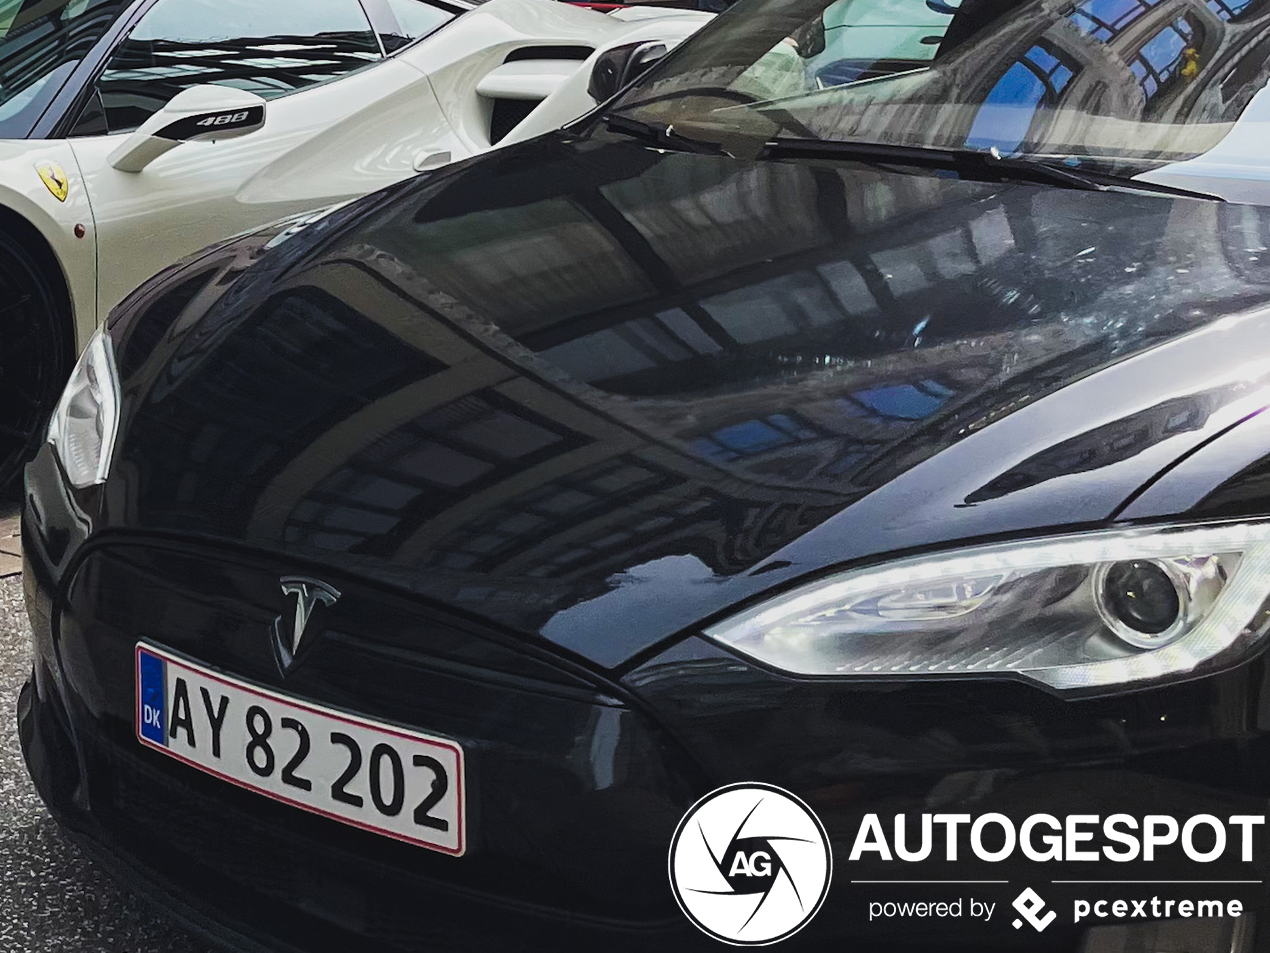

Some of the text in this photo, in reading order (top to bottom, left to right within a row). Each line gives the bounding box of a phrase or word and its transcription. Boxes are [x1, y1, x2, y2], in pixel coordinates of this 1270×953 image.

[196, 110, 250, 127] 488
[143, 703, 161, 730] DK
[169, 677, 449, 832] AY 82 202
